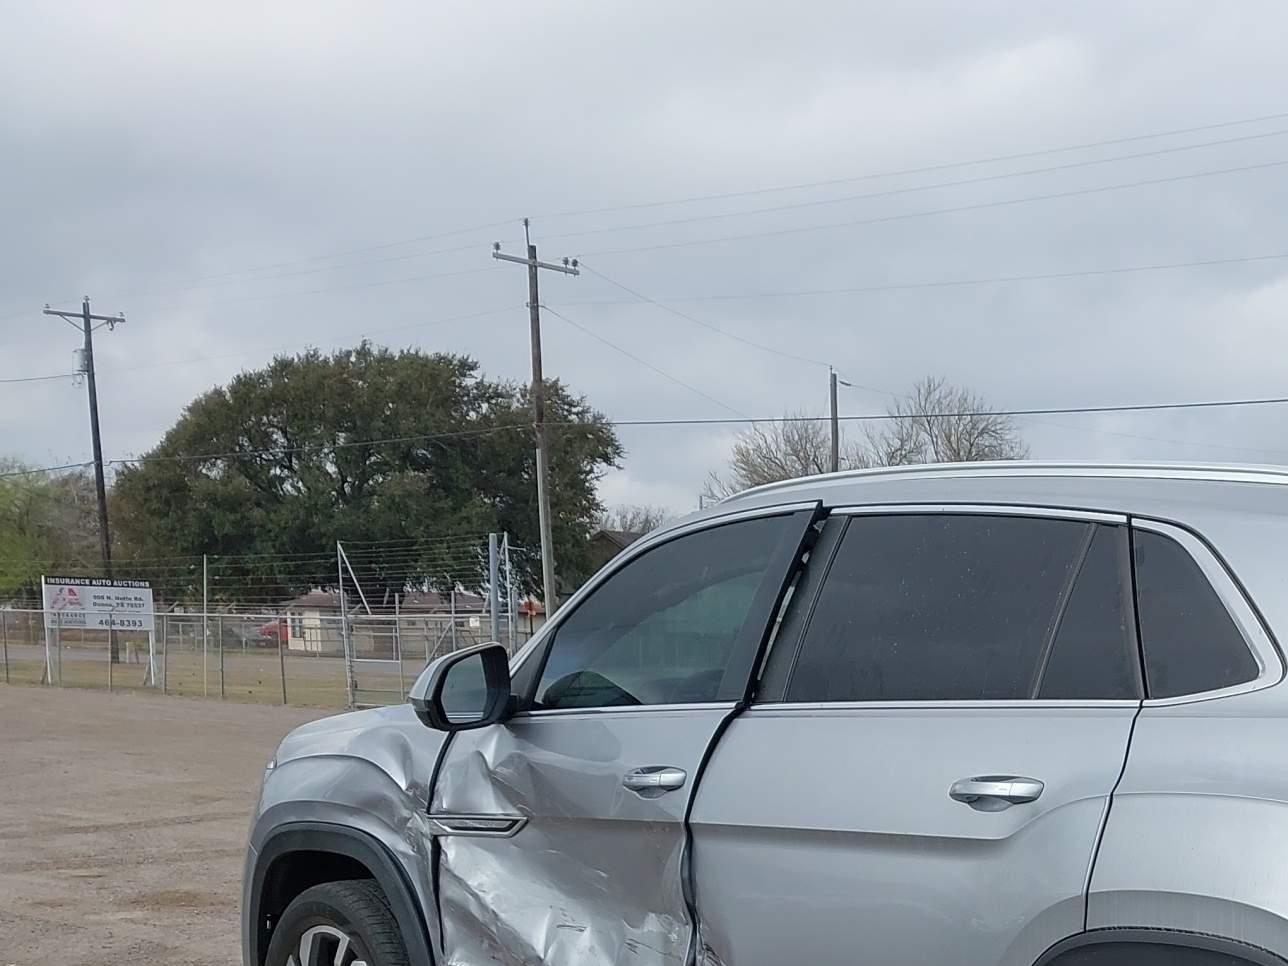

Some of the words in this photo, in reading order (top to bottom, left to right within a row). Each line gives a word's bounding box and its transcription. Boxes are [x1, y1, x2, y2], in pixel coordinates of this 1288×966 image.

[47, 577, 91, 585] INSURANCE
[91, 579, 113, 587] AUTO
[113, 580, 150, 588] AUCTIONS
[98, 619, 143, 628] 464-8393
